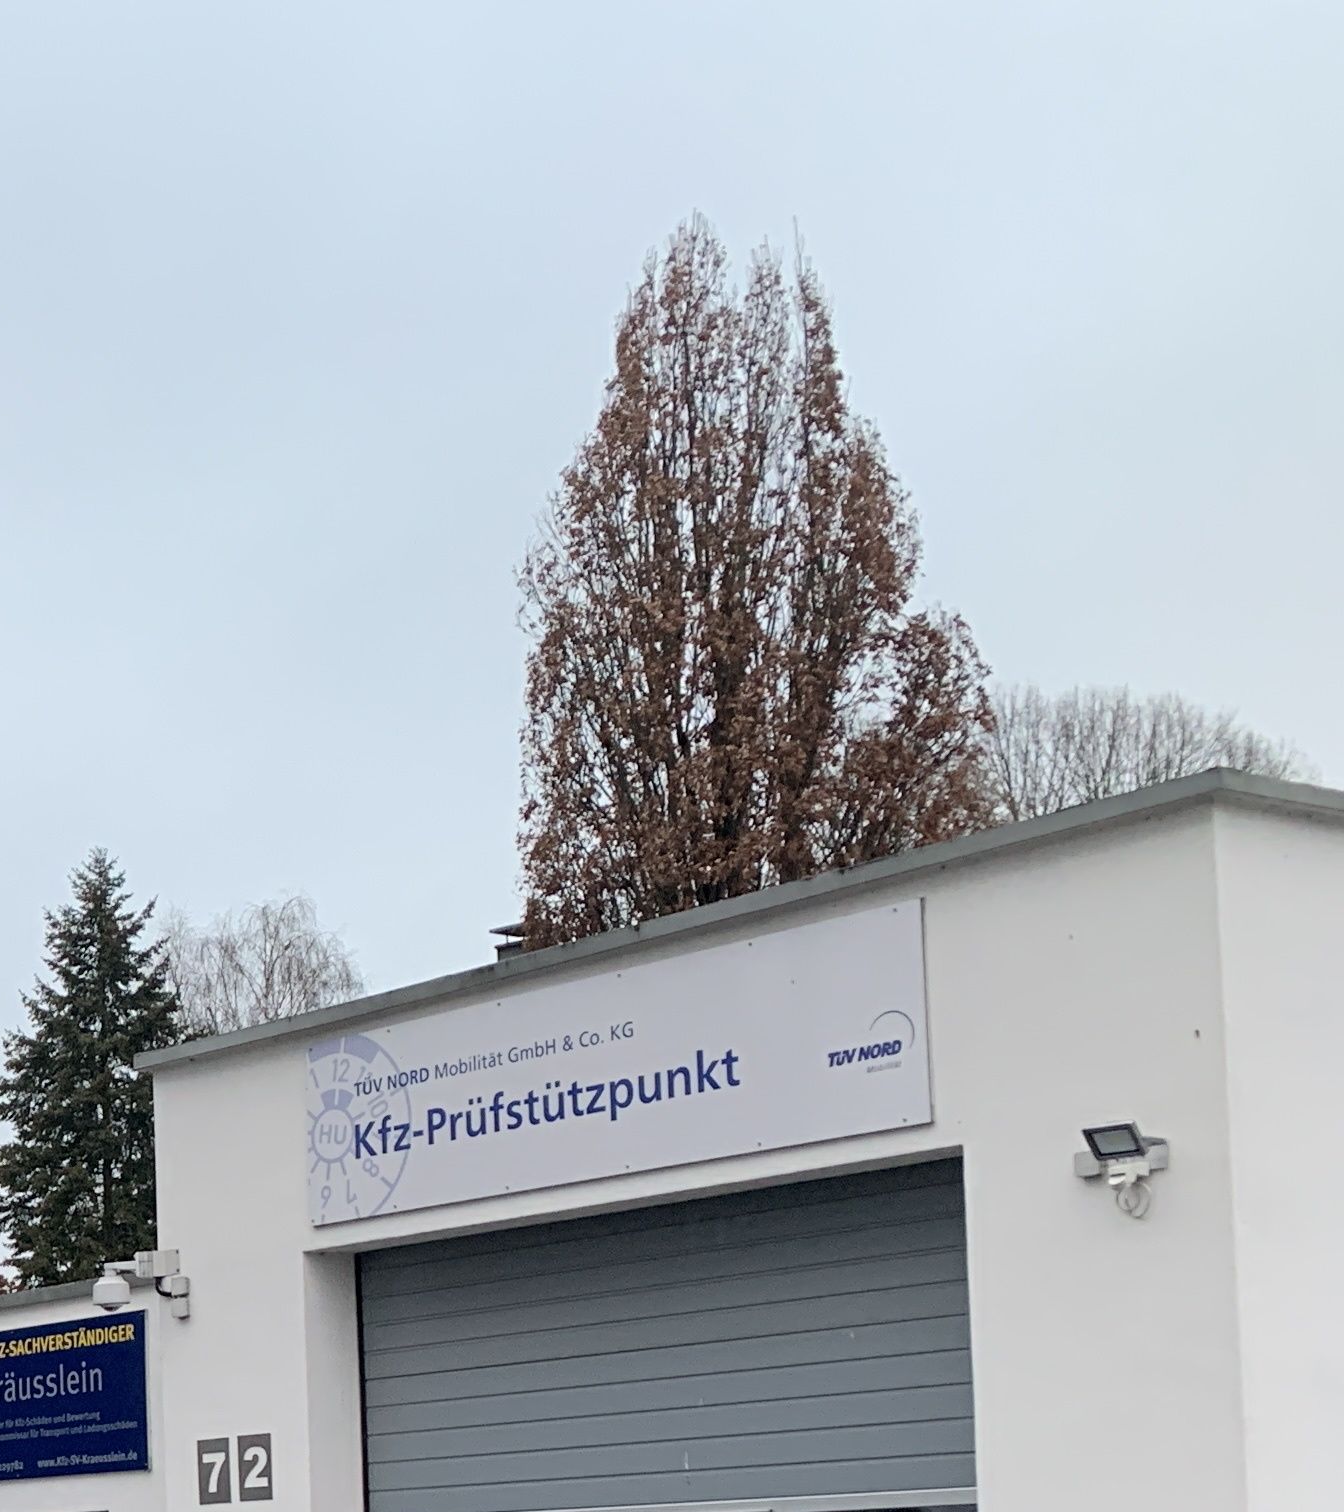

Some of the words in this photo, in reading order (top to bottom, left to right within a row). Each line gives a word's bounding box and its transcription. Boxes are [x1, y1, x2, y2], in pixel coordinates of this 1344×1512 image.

[332, 1058, 351, 1083] 12
[354, 1075, 383, 1097] TÜV
[387, 1067, 430, 1091] NORD
[435, 1050, 503, 1082] Mobilität
[508, 1037, 558, 1065] GmbH
[562, 1033, 574, 1052] &
[578, 1029, 605, 1048] Co.
[610, 1020, 635, 1041] KG
[828, 1047, 857, 1067] TÜV
[857, 1039, 902, 1062] NORD
[353, 1048, 741, 1160] Kfz-Prüfstützpunkt
[318, 1123, 348, 1146] HU
[200, 1446, 269, 1495] 72
